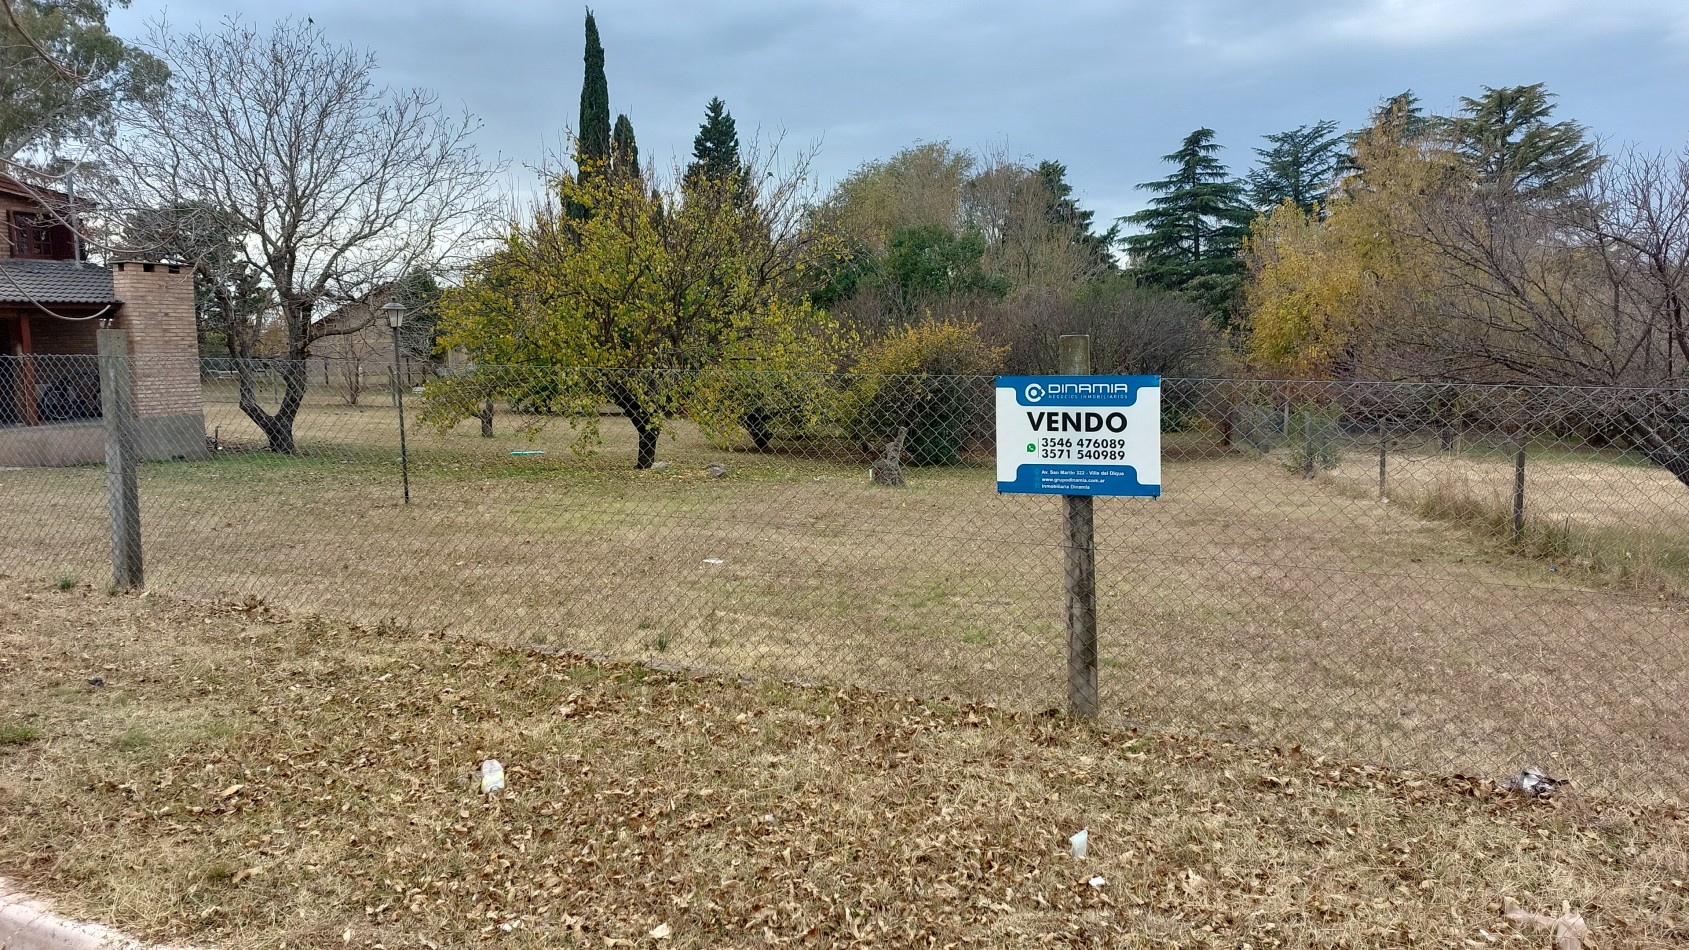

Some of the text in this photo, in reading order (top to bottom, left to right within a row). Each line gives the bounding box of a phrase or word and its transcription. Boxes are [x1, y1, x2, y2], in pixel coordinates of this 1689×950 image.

[1048, 384, 1128, 394] DINAMIA
[1027, 412, 1128, 432] VENDO
[1042, 438, 1125, 449] 3546 476089
[1042, 449, 1125, 460] 3571 540989
